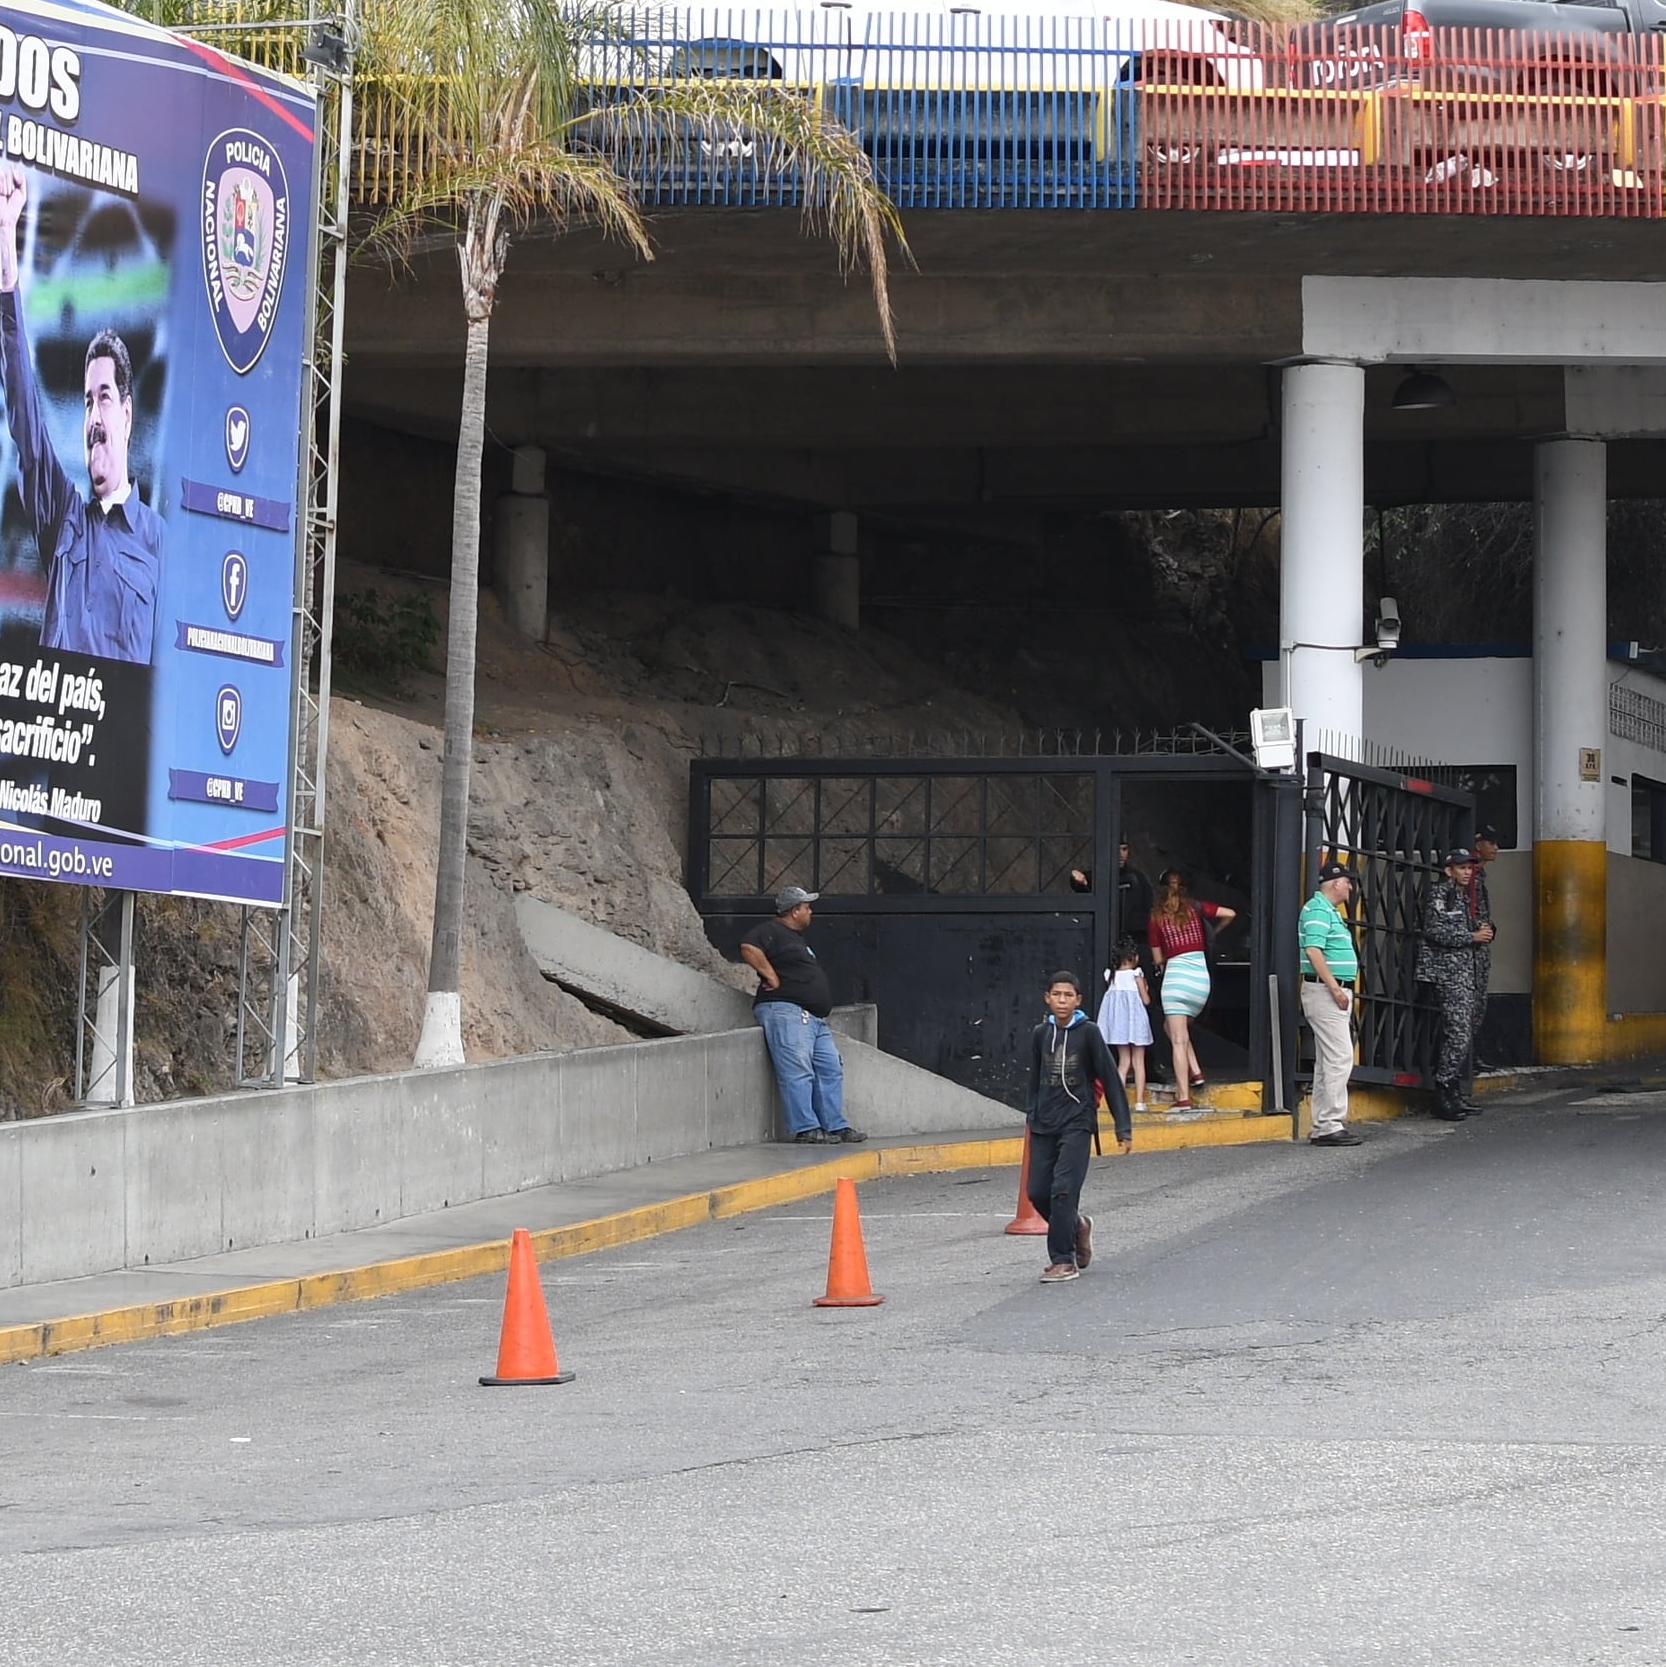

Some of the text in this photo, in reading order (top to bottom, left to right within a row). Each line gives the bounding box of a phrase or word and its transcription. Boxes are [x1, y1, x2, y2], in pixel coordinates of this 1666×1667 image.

[6, 113, 139, 194] BOLIVARIANA
[226, 141, 271, 177] POLICIA
[205, 180, 224, 312] NACIONAL
[257, 197, 286, 333] BOLIVARIANA
[25, 659, 60, 704] del
[58, 667, 106, 721] país,
[50, 787, 102, 823] Maduro
